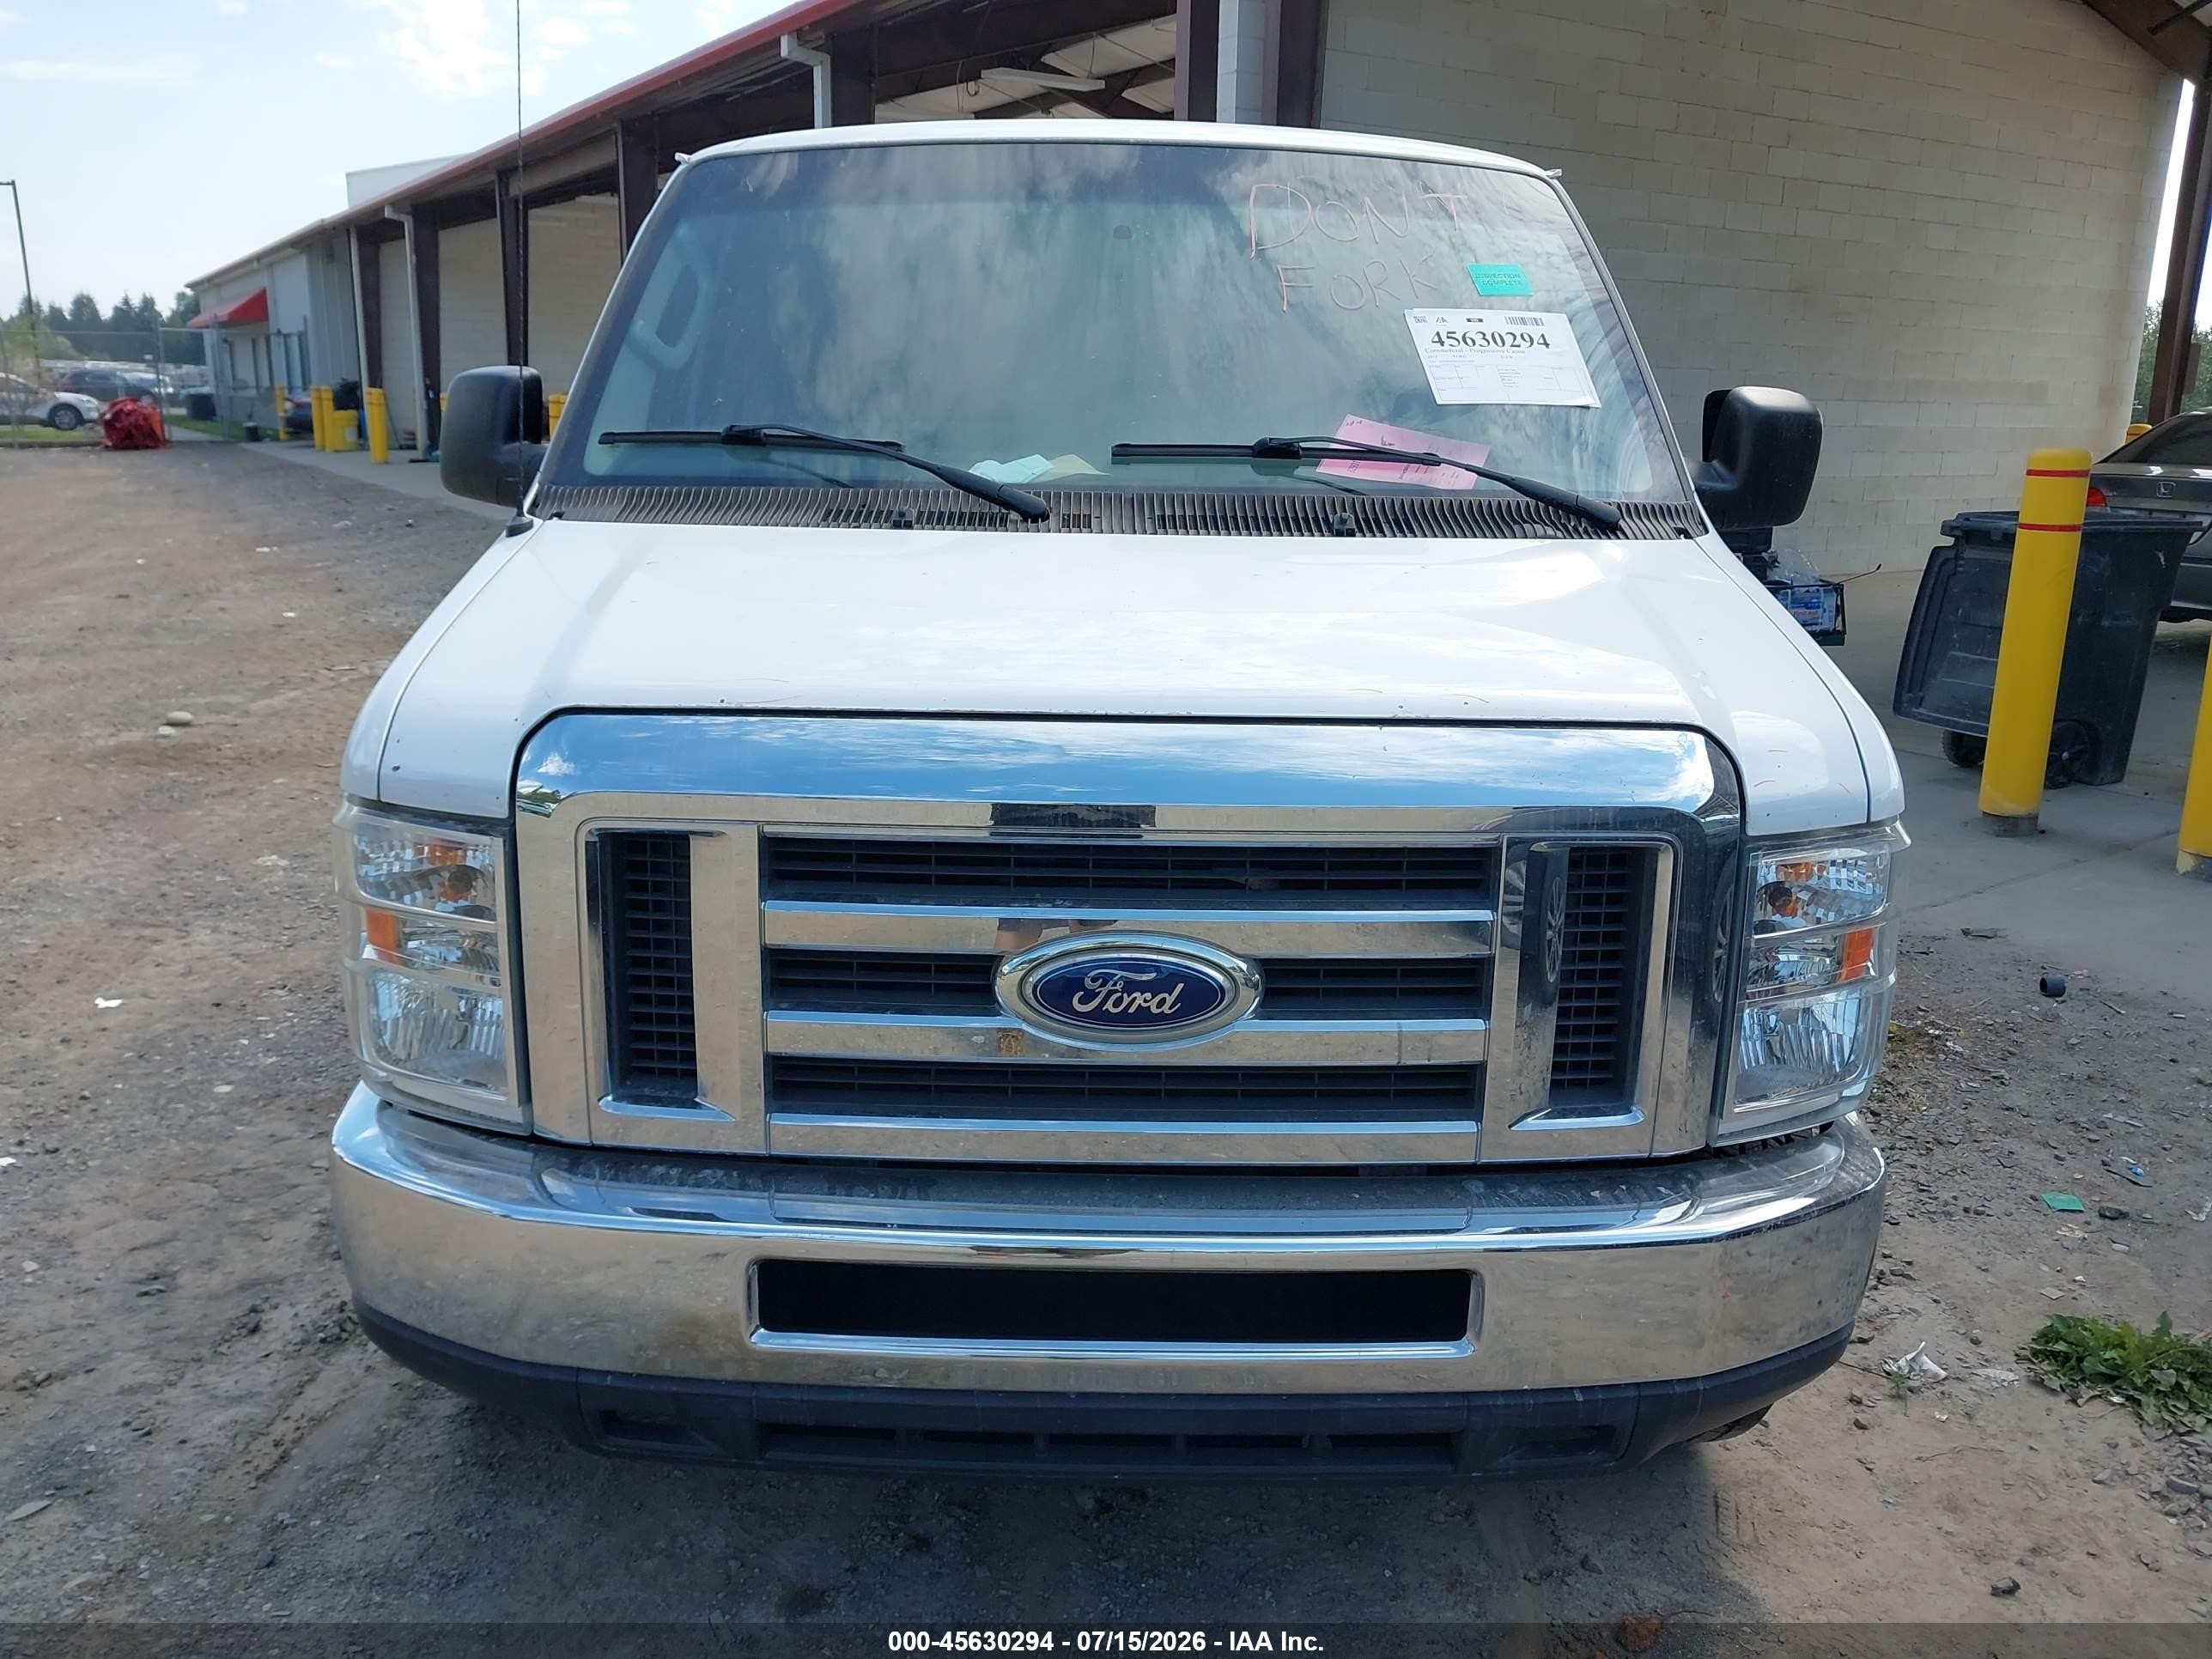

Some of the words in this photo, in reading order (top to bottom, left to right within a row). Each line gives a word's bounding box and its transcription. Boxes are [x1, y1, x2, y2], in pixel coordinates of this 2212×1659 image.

[1277, 254, 1439, 313] FORK
[1431, 331, 1551, 349] 45630294
[1073, 969, 1185, 1014] Ford
